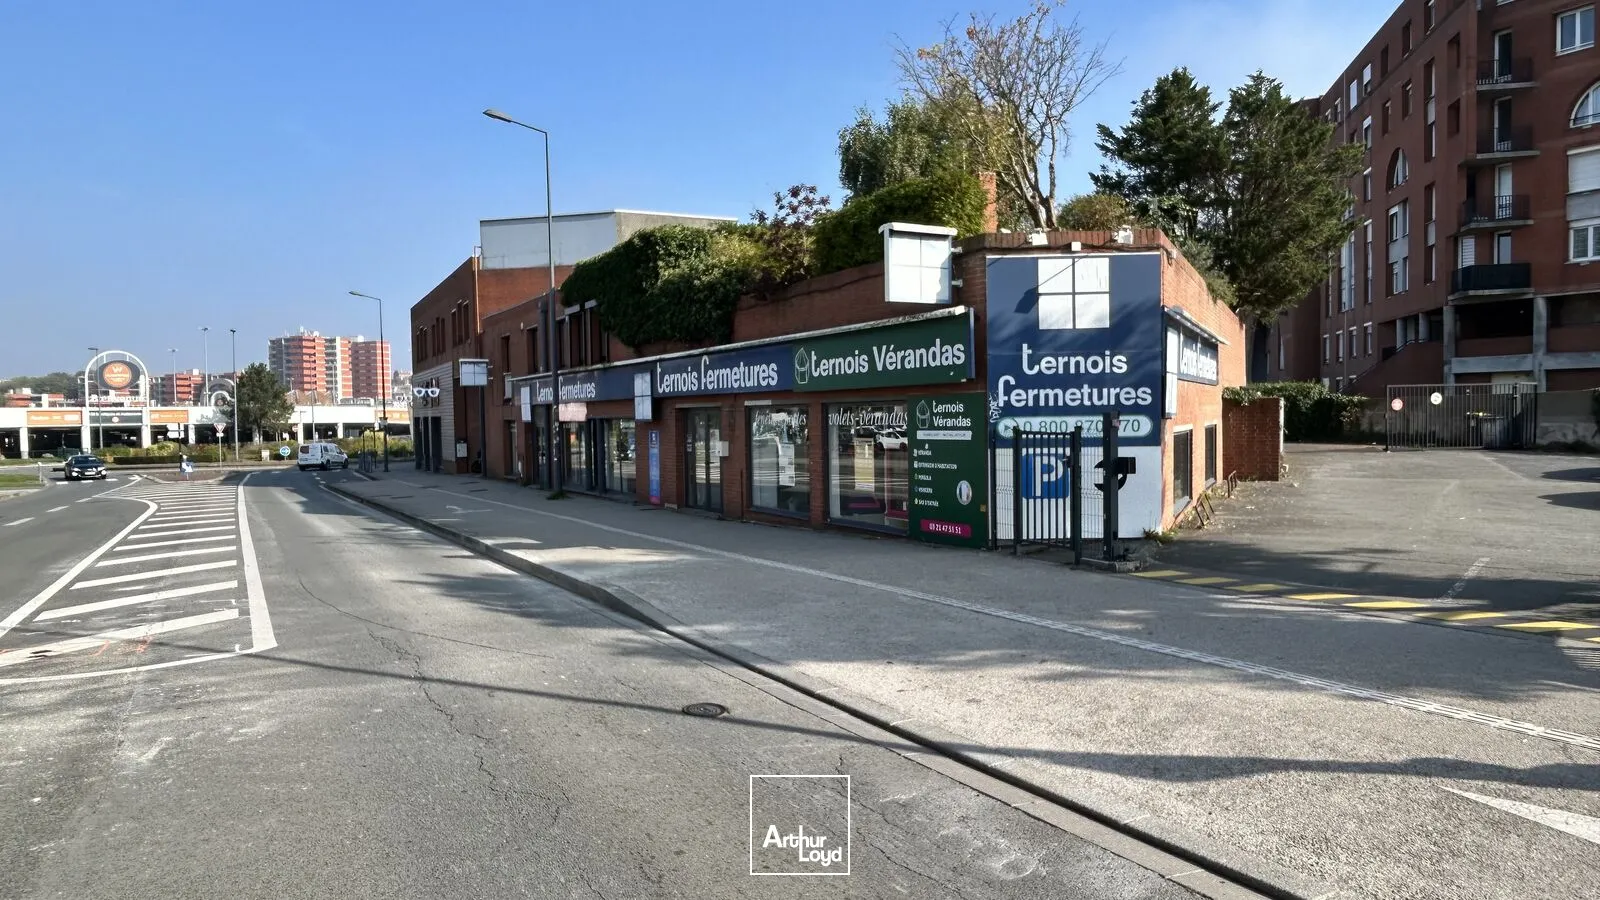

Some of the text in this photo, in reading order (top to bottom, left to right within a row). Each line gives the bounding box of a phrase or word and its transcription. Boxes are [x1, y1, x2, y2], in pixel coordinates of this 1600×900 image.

[872, 338, 966, 371] Vérandas
[536, 380, 553, 402] terno
[932, 416, 971, 427] Vérandas
[1118, 419, 1140, 432] 70
